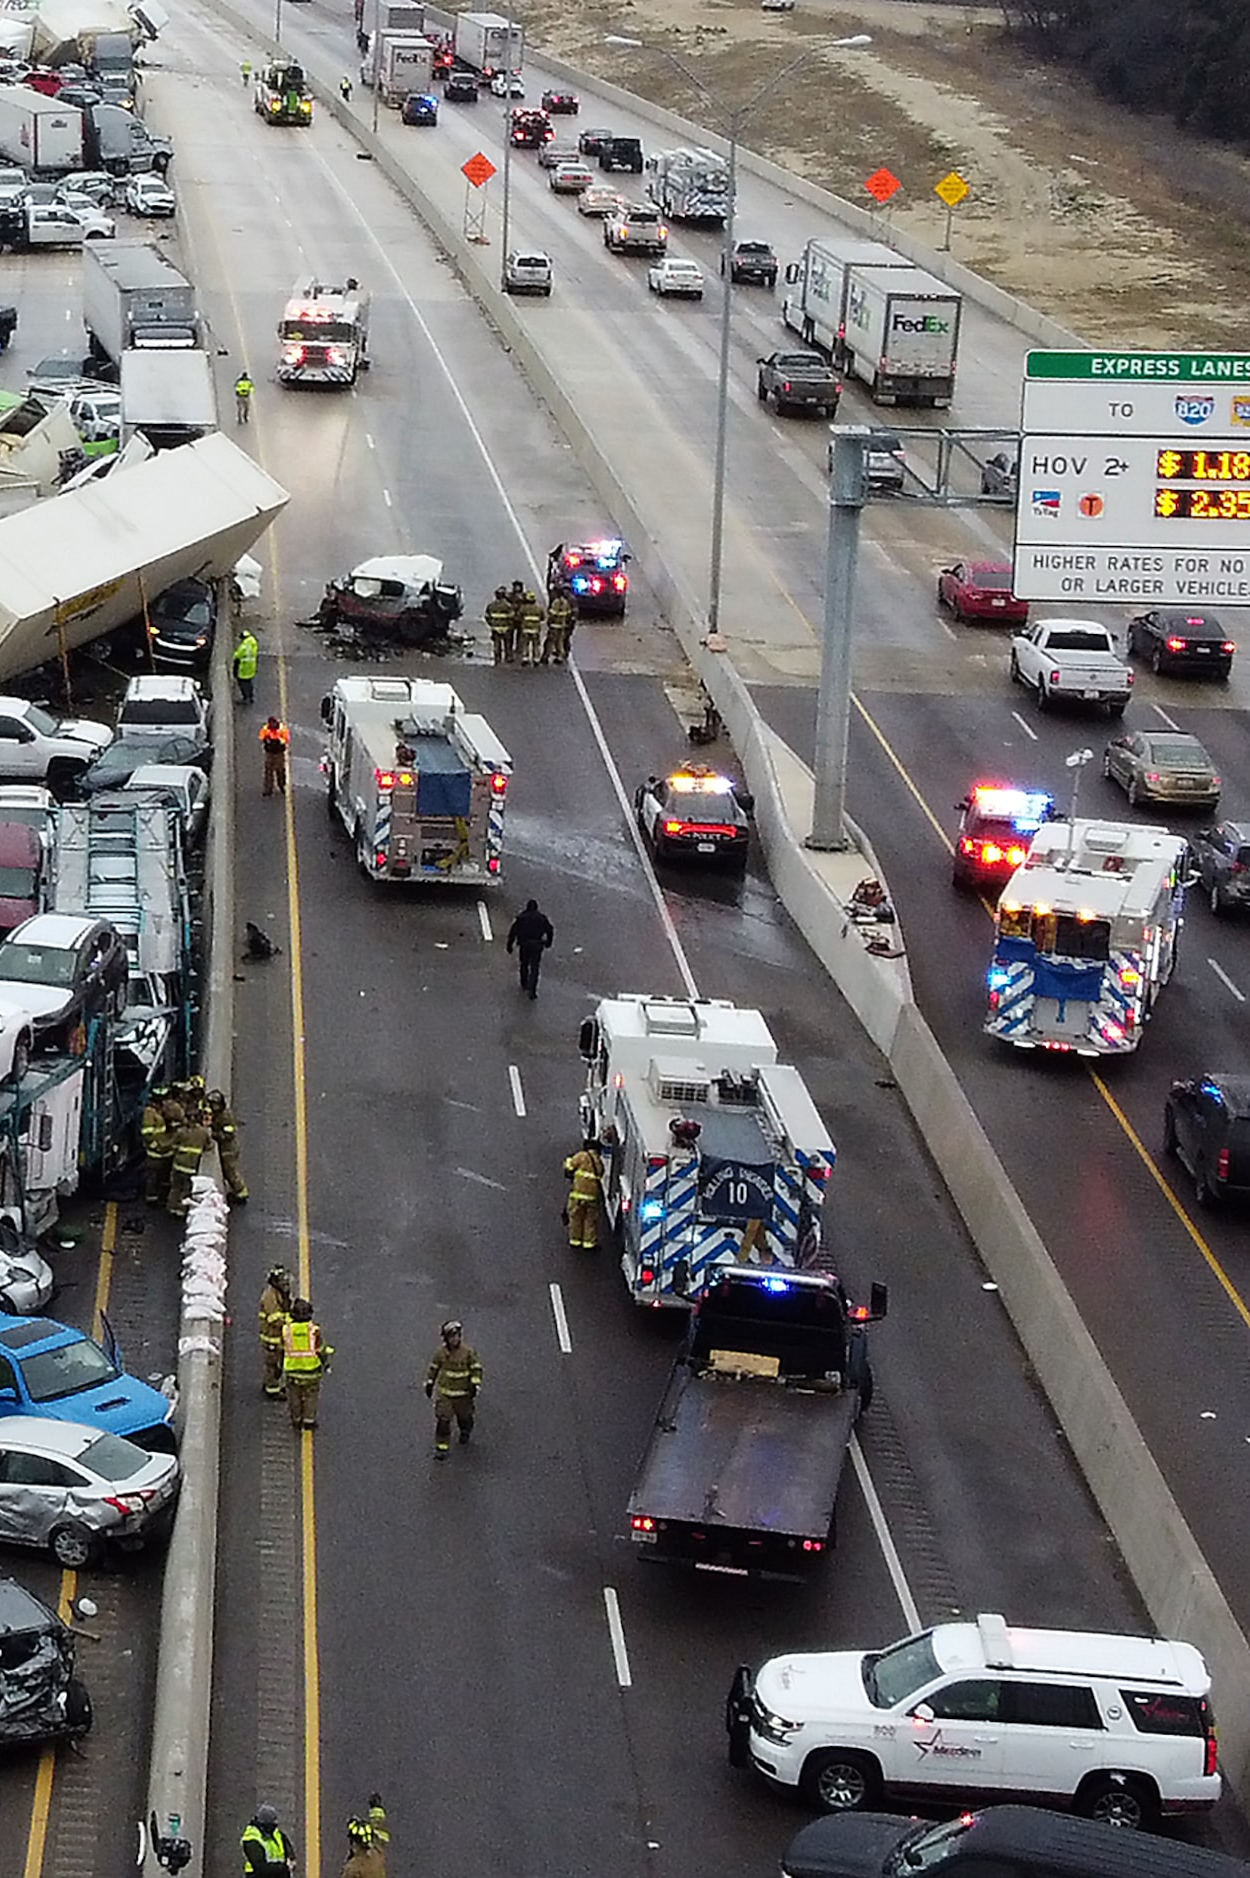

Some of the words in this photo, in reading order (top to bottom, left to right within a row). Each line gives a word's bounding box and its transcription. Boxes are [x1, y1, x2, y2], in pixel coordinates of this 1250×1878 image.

[893, 314, 949, 334] FedEx
[1091, 359, 1180, 376] EXPRESS
[1109, 403, 1134, 417] TO
[1178, 402, 1211, 418] 820
[1032, 456, 1087, 476] HOV
[1104, 458, 1129, 476] 2+
[1193, 452, 1250, 479] 1.18
[1191, 491, 1250, 518] 2.35
[1034, 555, 1096, 570] HIGHER
[1107, 556, 1163, 572] RATES
[1174, 558, 1208, 573] FOR
[1221, 560, 1244, 574] NO
[1061, 577, 1084, 593] OR
[1096, 579, 1163, 594] LARGER
[1175, 580, 1250, 597] VEHICLE
[729, 1182, 747, 1204] 10
